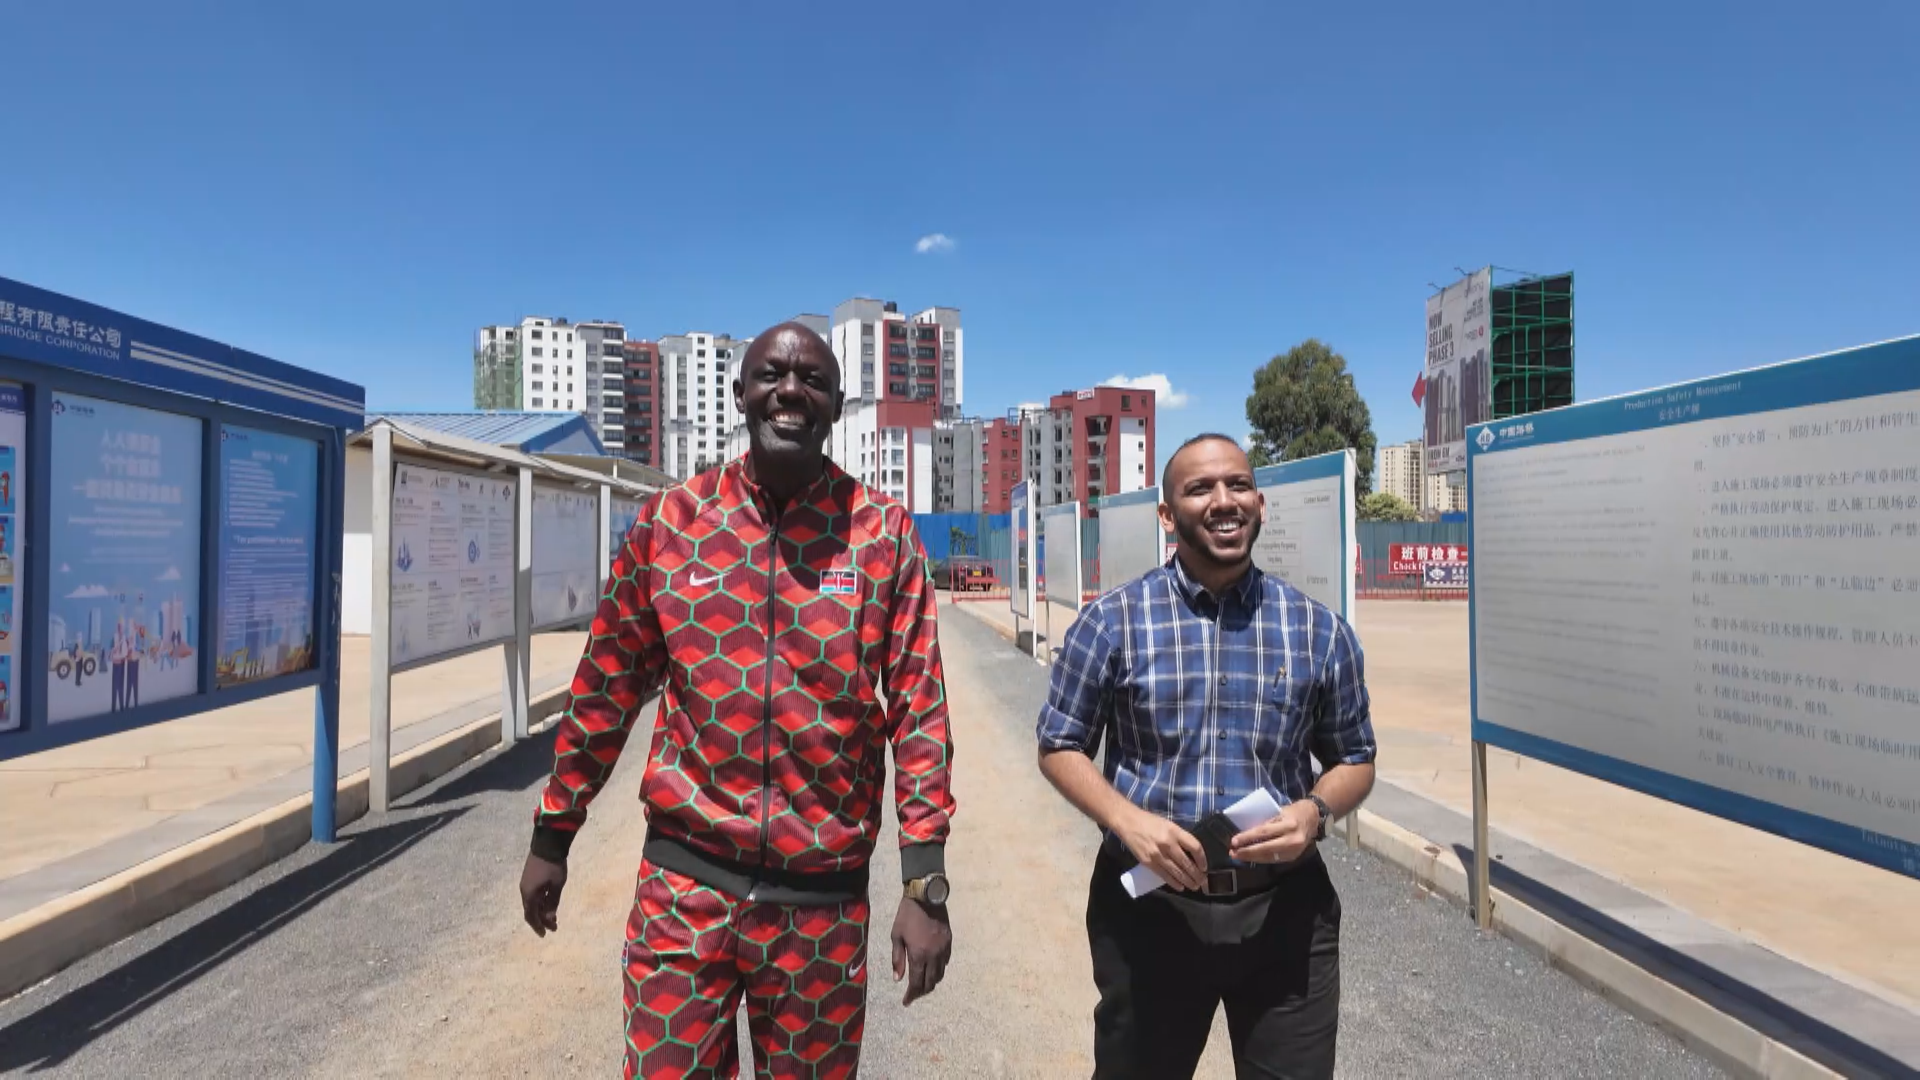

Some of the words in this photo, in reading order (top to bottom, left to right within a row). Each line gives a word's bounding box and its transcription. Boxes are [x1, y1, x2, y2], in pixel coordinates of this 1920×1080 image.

[1429, 310, 1442, 330] NOW
[45, 334, 120, 360] CORPORATION
[1429, 323, 1453, 348] SELLING
[1429, 343, 1449, 366] PHASE
[1450, 340, 1455, 357] 3
[1624, 396, 1664, 411] Production
[1667, 390, 1692, 403] Safety
[1696, 381, 1741, 397] Management
[1393, 561, 1417, 571] Check
